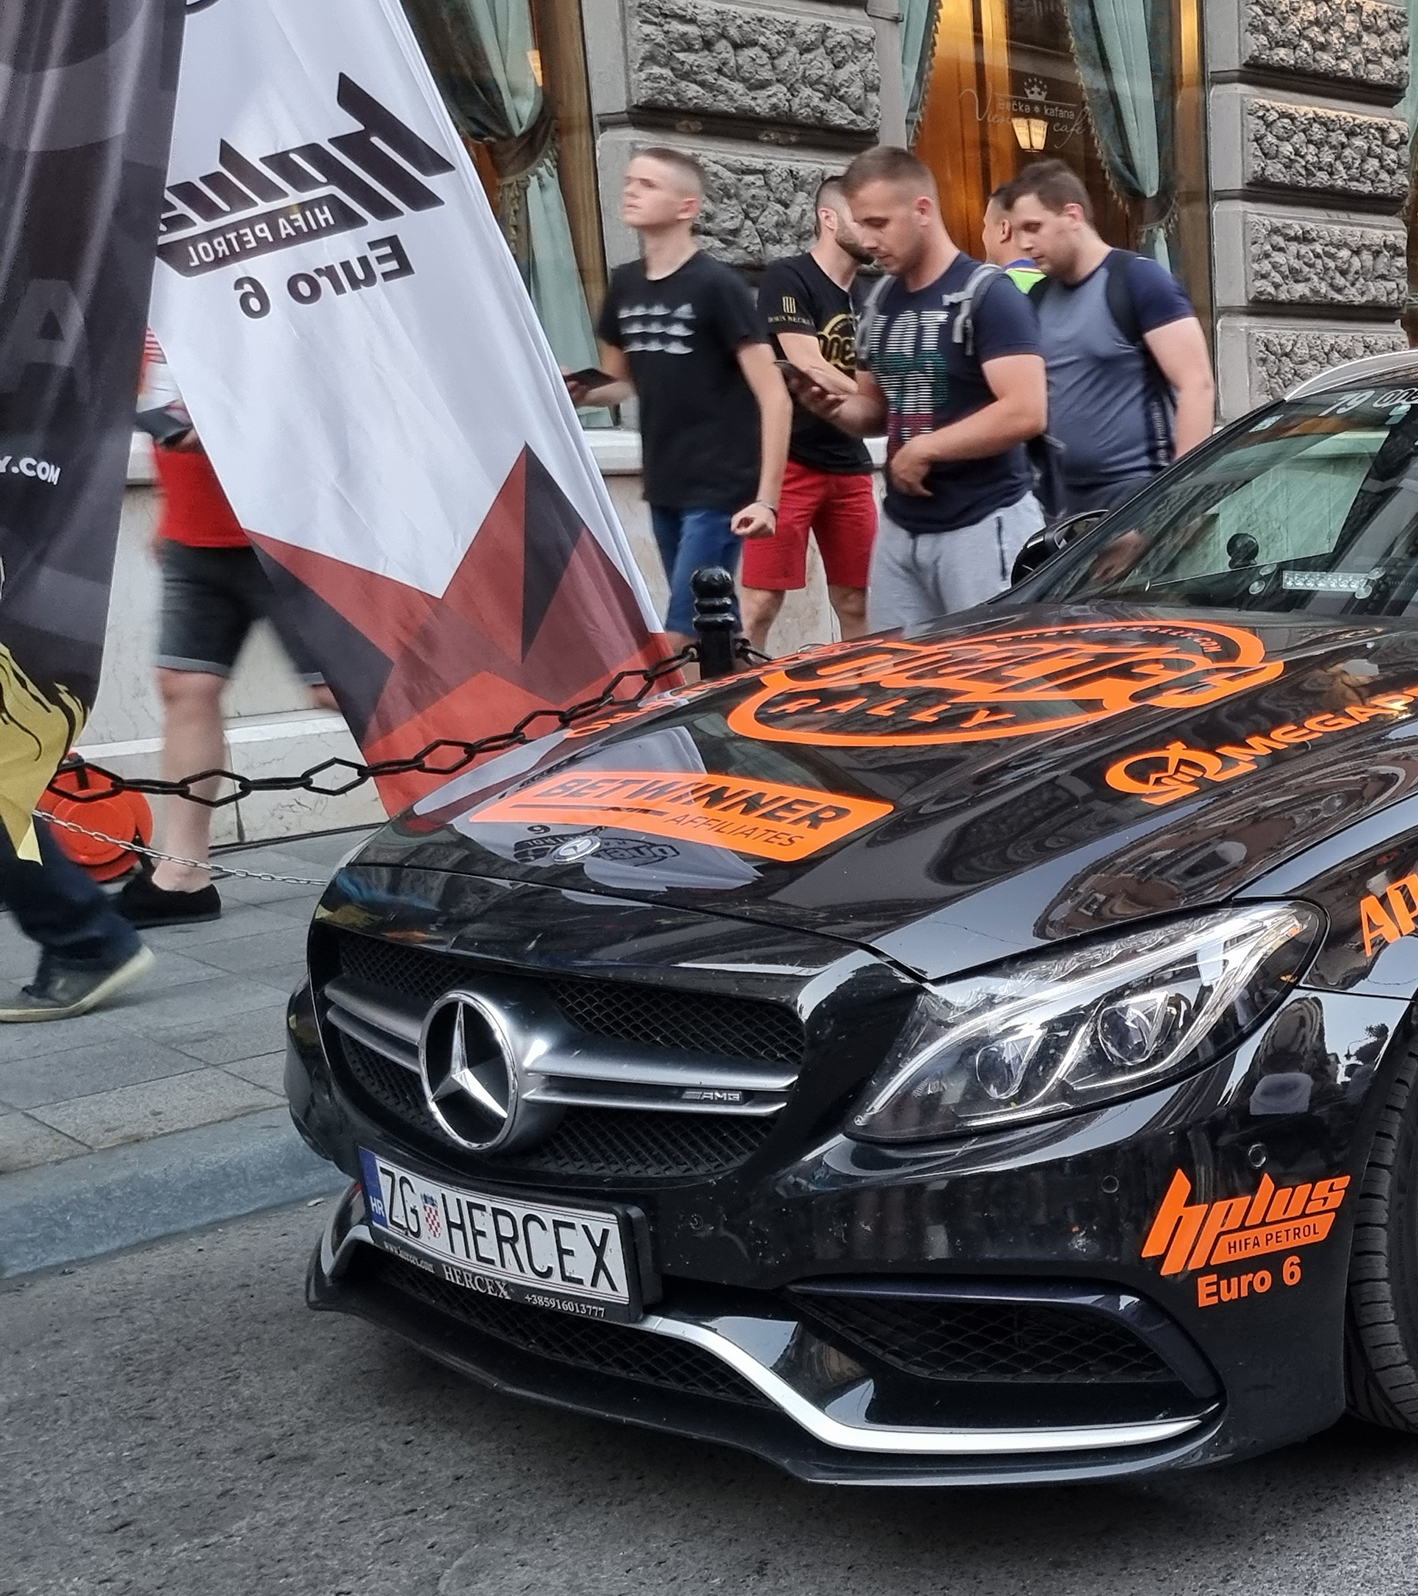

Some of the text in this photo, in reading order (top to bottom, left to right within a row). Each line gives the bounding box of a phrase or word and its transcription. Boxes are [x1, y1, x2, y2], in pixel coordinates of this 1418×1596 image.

[1043, 104, 1076, 120] kafana
[1320, 389, 1376, 417] 79
[768, 697, 1017, 729] RALLY
[533, 777, 853, 831] BETWINNER
[665, 811, 806, 849] AFFILIATES
[700, 1091, 741, 1102] AMG
[369, 1195, 386, 1218] HR
[1141, 1167, 1351, 1276] hplus
[379, 1166, 620, 1293] ZG HERCEX
[1227, 1222, 1320, 1256] HIFA PETROL
[441, 1262, 512, 1301] HERCEX
[524, 1293, 606, 1318] +385916013777
[1196, 1254, 1302, 1308] Euro 6
